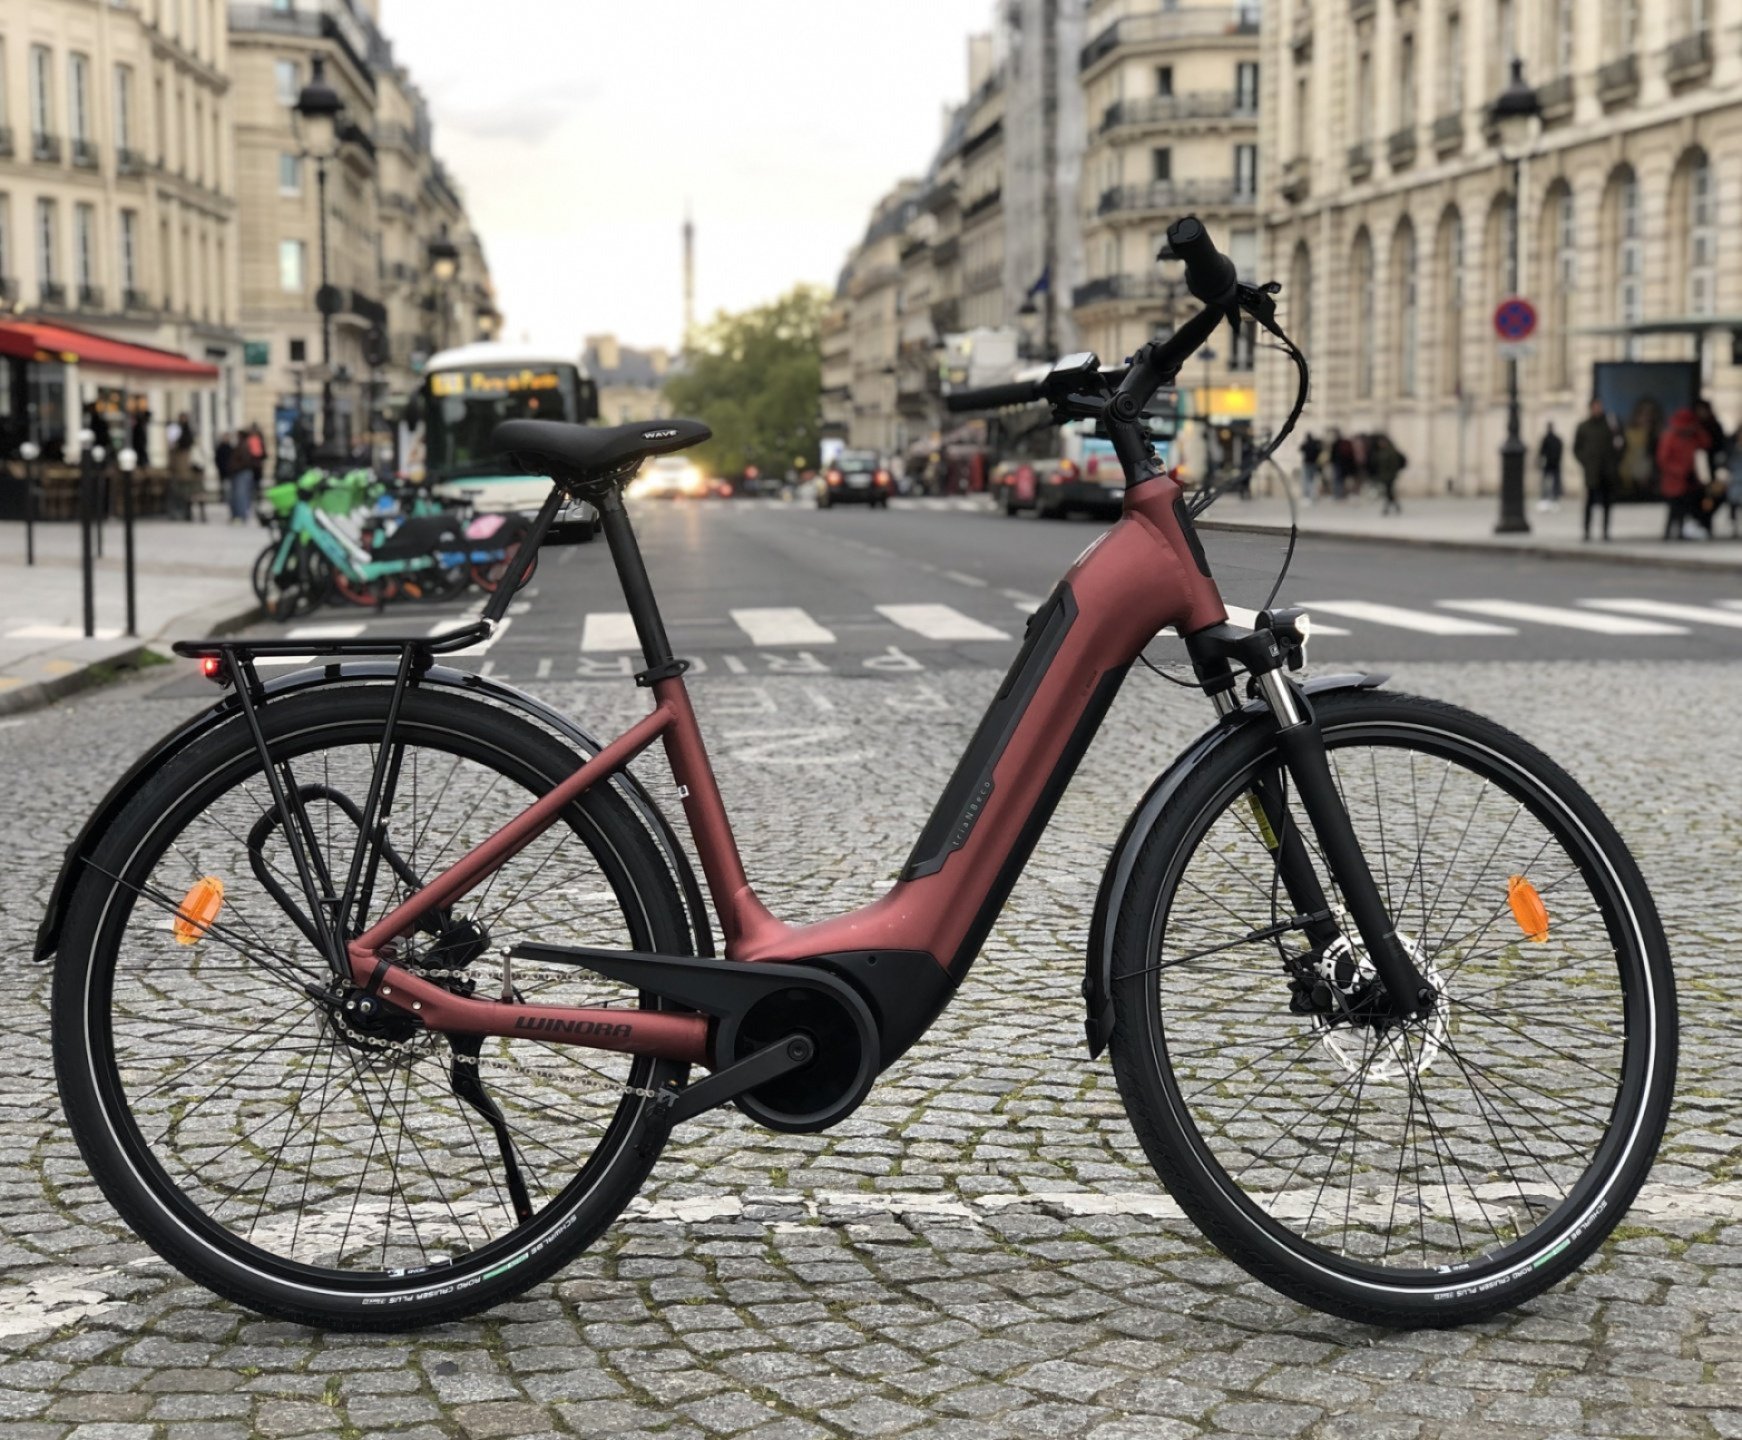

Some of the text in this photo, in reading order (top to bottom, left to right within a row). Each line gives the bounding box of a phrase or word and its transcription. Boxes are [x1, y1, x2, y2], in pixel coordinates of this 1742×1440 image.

[643, 429, 678, 439] WAVE
[514, 1016, 633, 1038] WINORA
[456, 1275, 481, 1291] ROAD
[388, 1295, 414, 1304] PLUS
[416, 1285, 454, 1300] CRUISER
